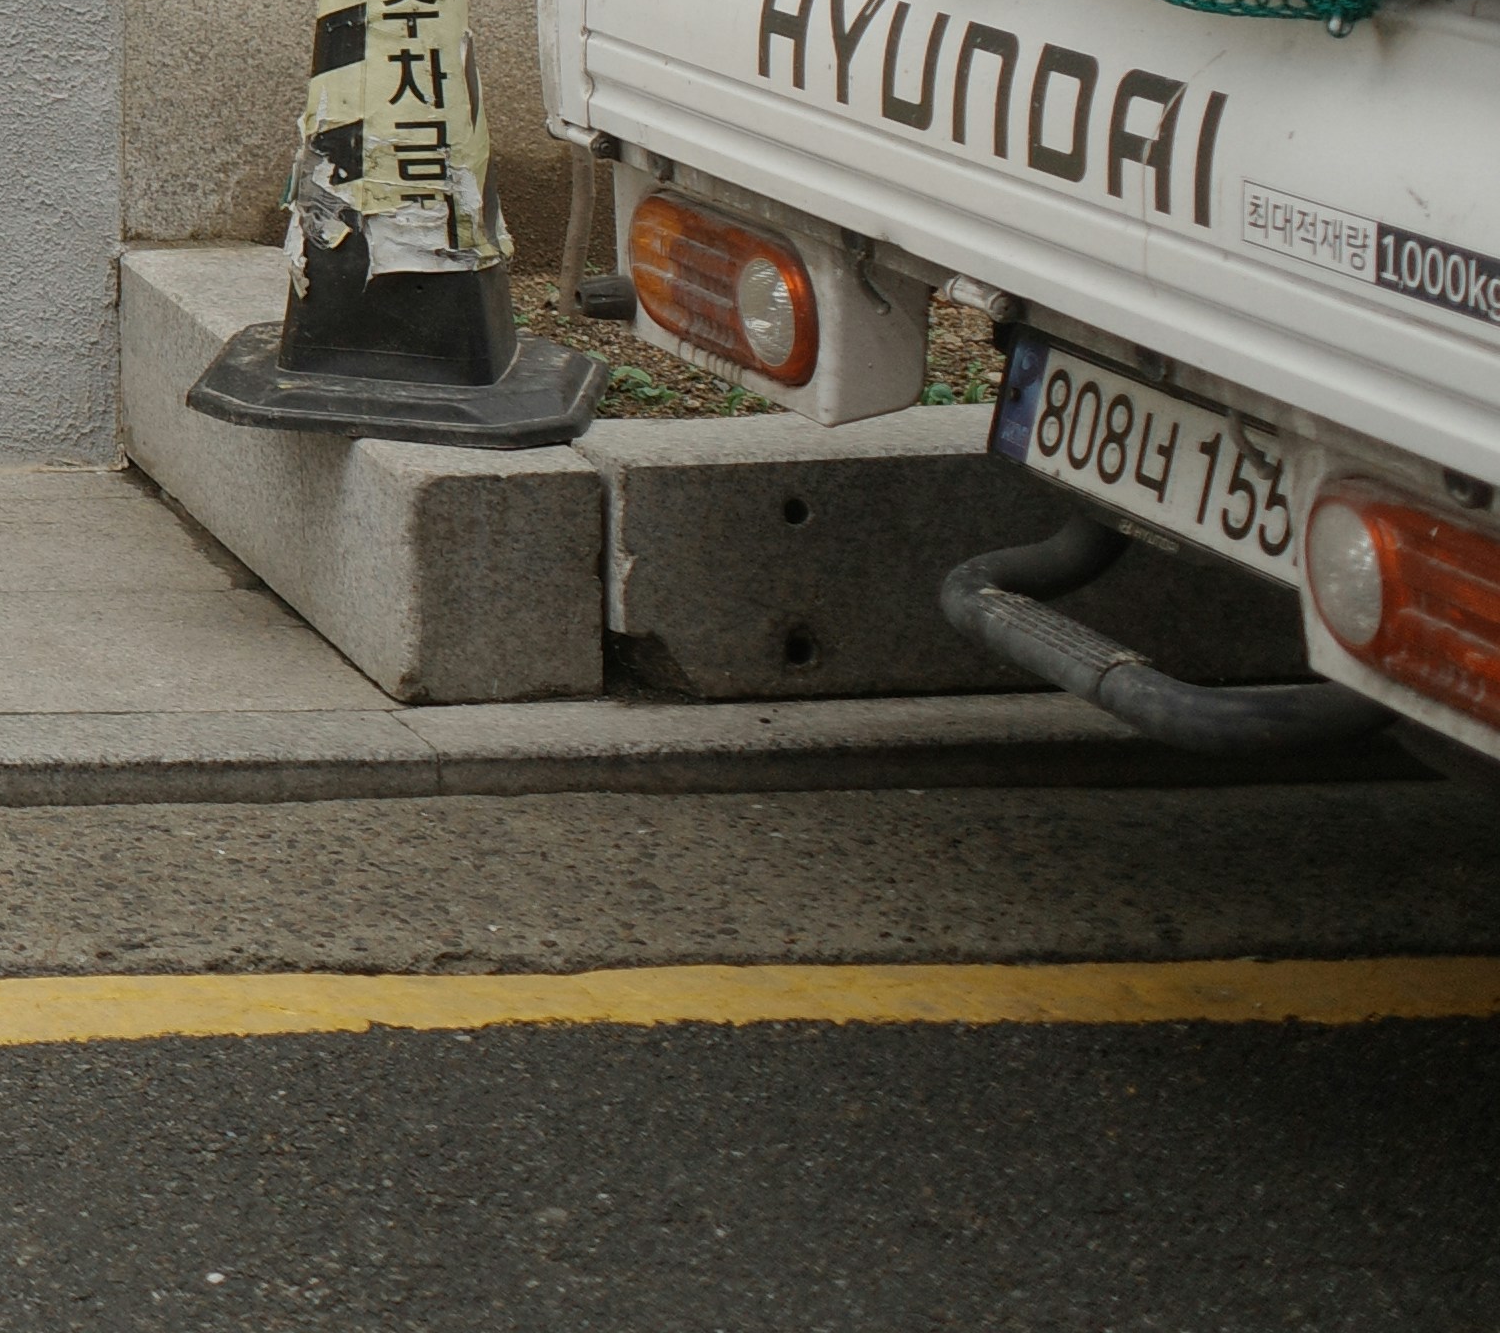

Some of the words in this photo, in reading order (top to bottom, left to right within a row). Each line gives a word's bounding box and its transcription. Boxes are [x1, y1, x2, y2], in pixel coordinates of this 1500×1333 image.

[1247, 194, 1370, 272] 최대적재량
[1036, 368, 1181, 504] 808너
[1196, 432, 1299, 568] 155
